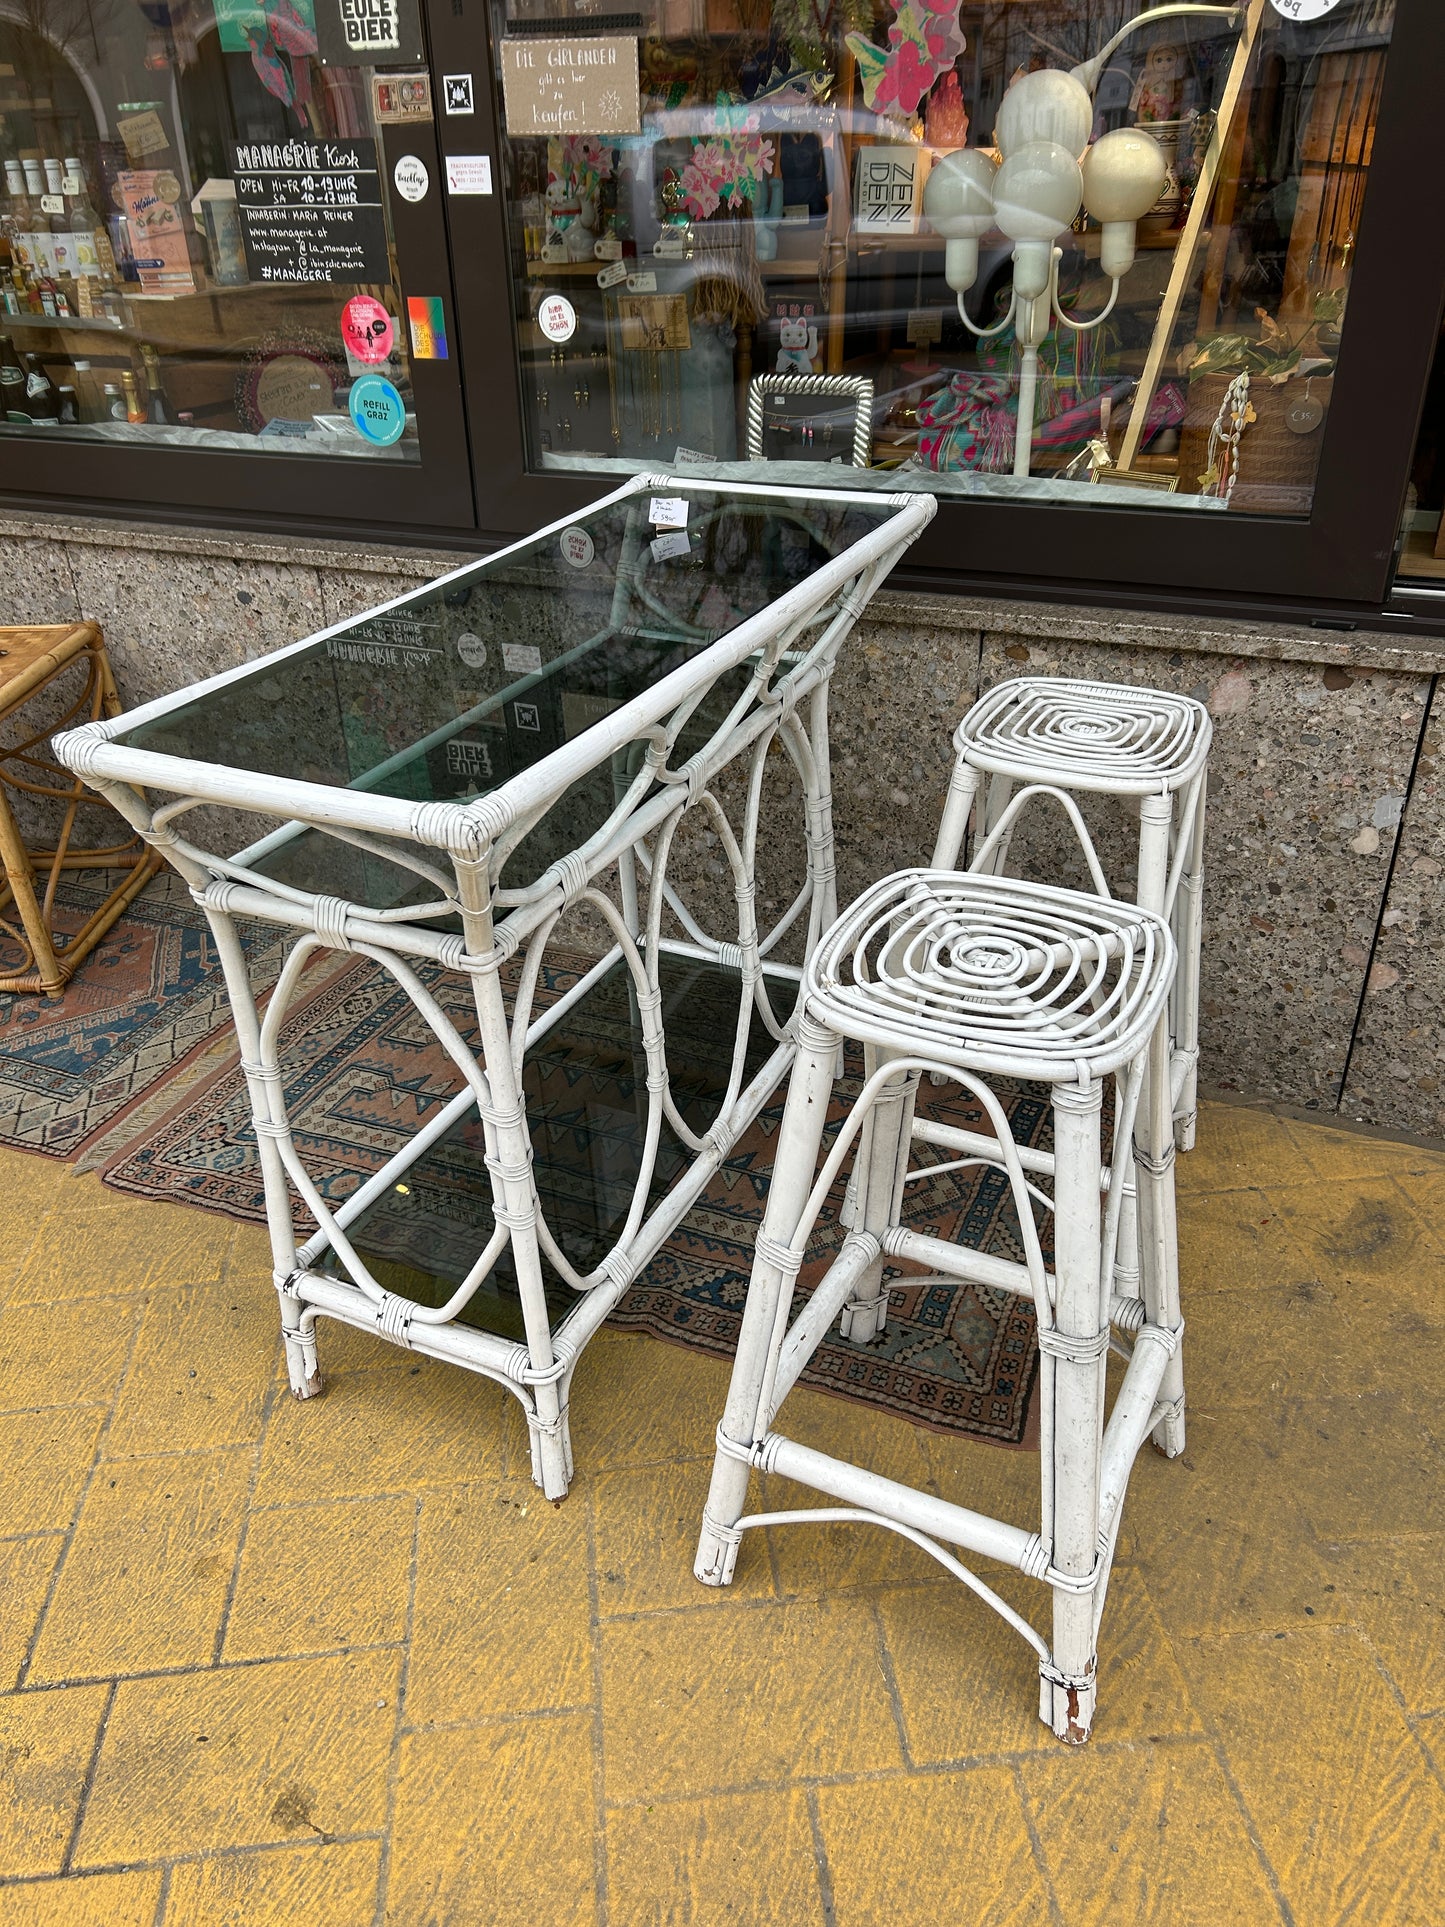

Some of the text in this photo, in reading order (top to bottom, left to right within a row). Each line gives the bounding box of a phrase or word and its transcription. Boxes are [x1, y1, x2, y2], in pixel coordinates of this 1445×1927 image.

[342, 0, 392, 19] EULE
[347, 18, 393, 42] BIER
[553, 91, 563, 100] zu
[323, 143, 360, 169] Kiosk
[239, 178, 264, 193] OPEN
[334, 175, 358, 190] UHR
[866, 162, 890, 223] DEN
[891, 162, 915, 223] ZEN
[273, 193, 287, 205] SA
[337, 192, 358, 204] UHR
